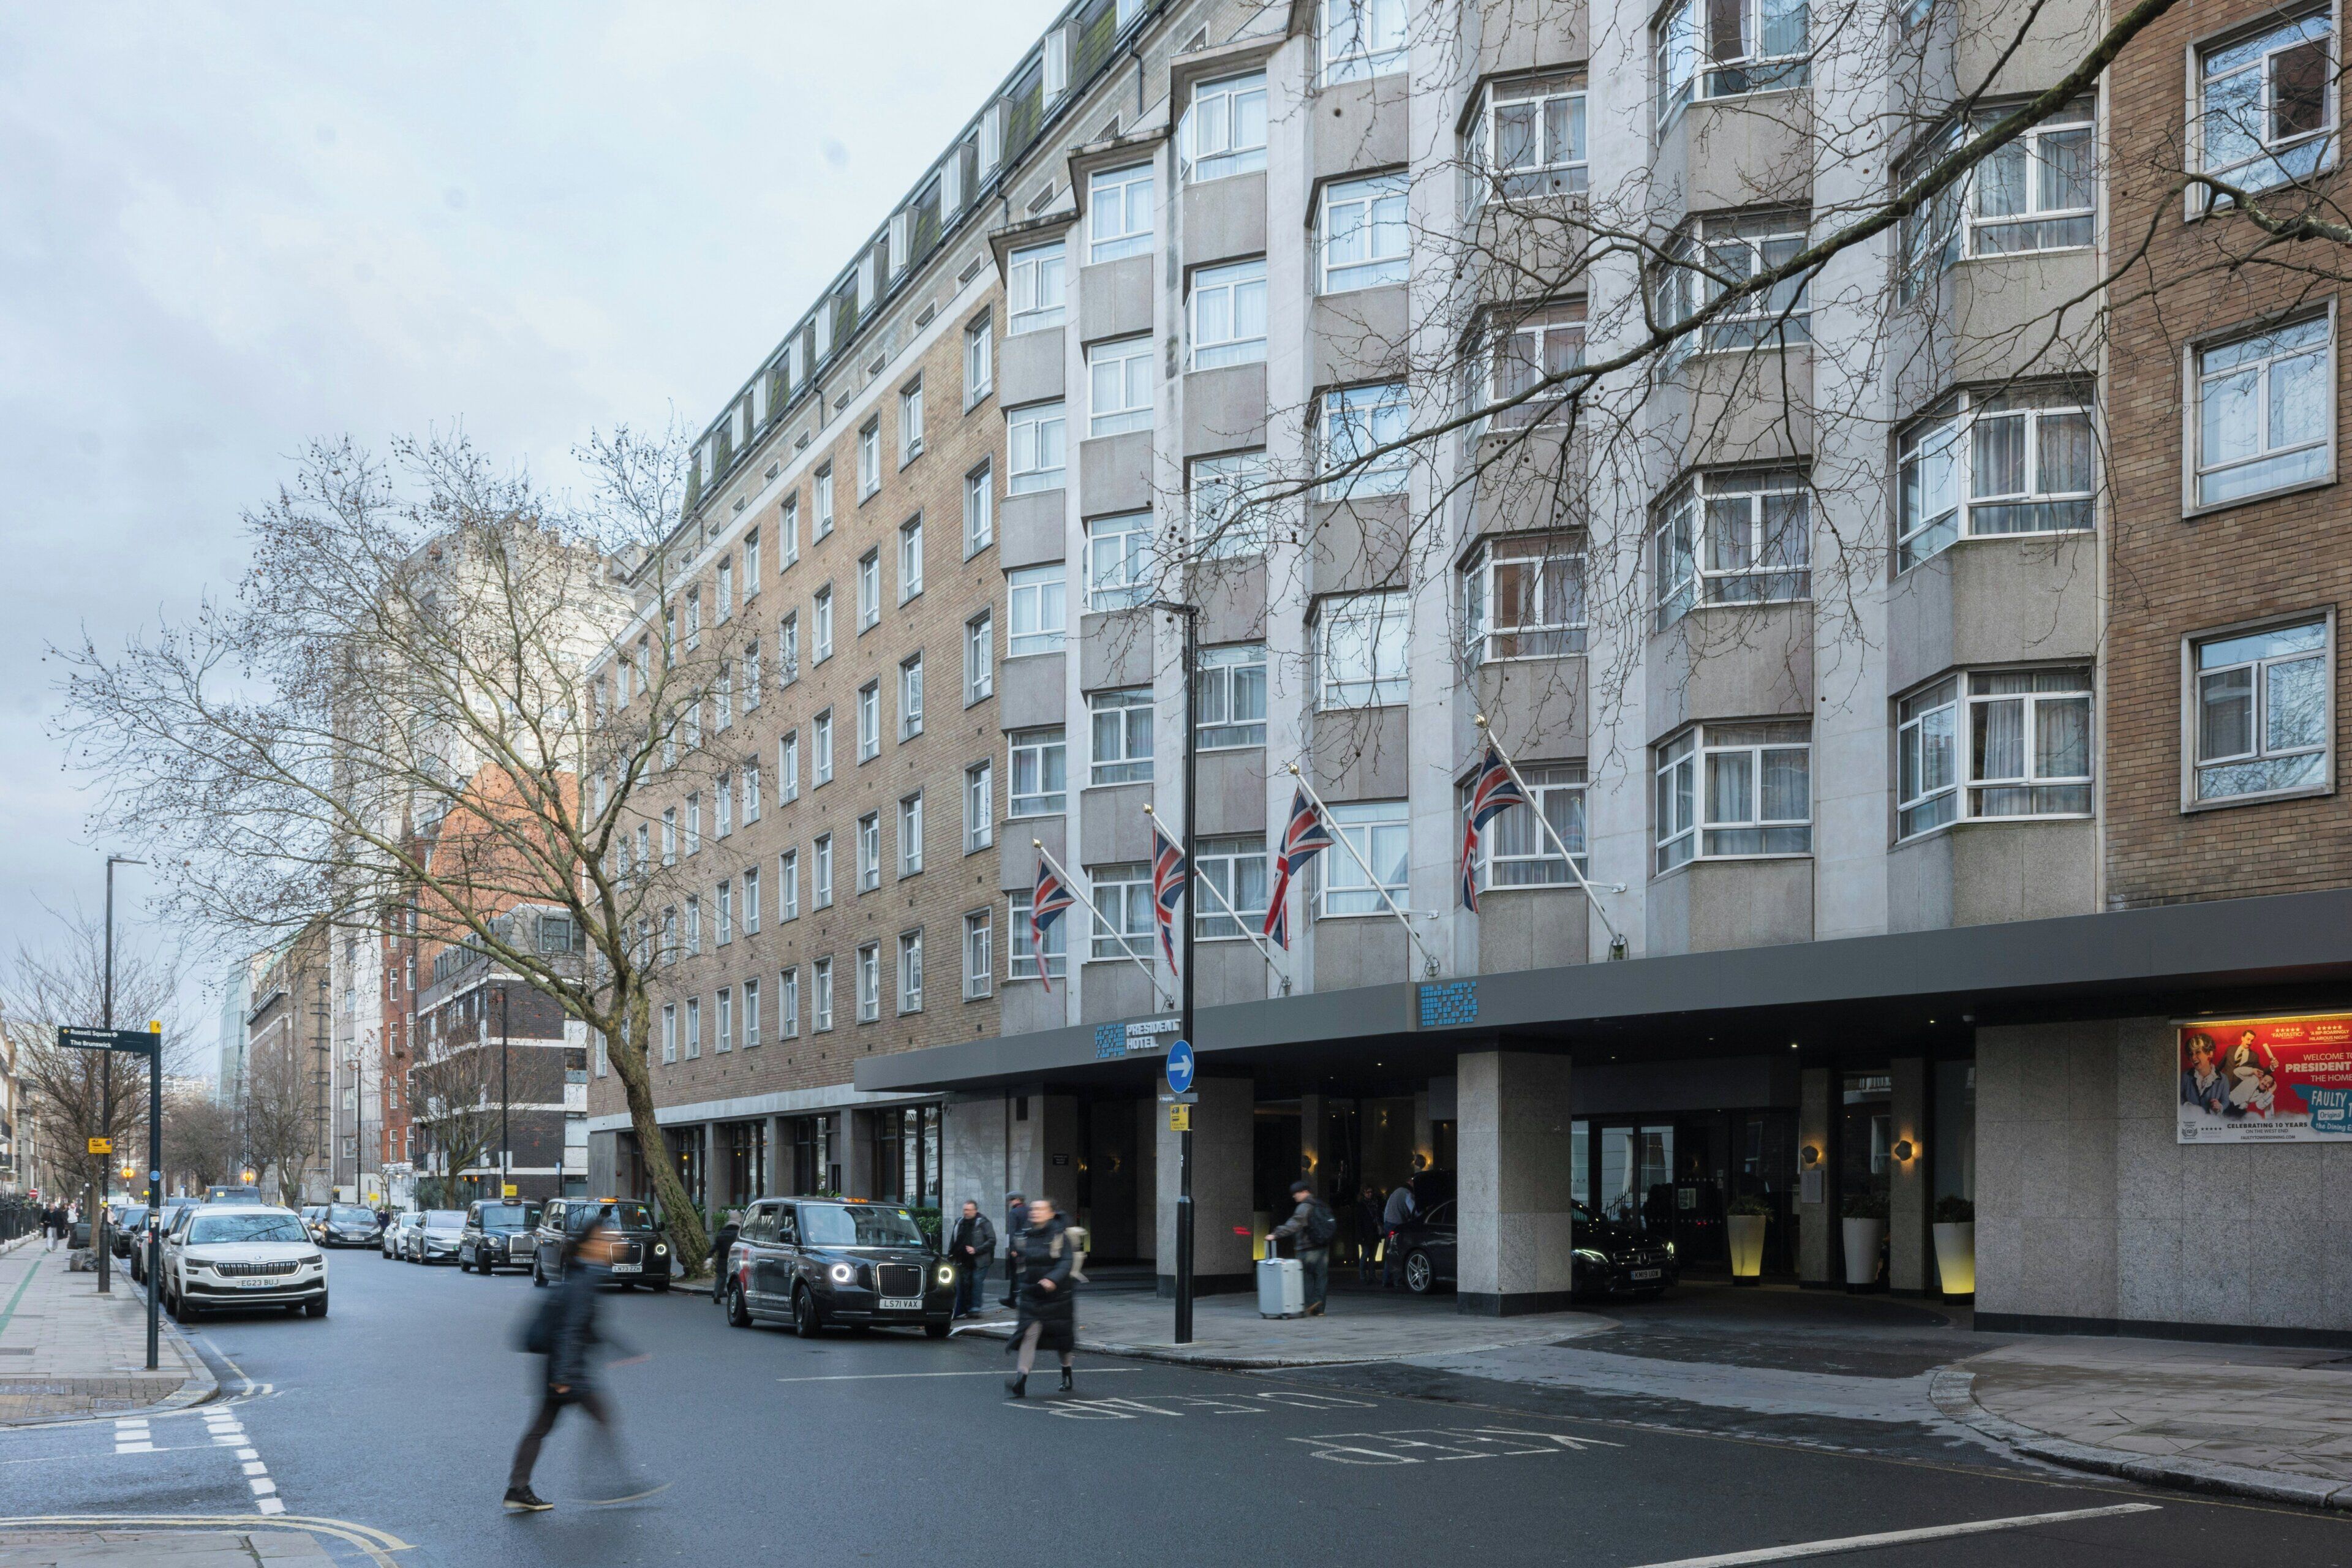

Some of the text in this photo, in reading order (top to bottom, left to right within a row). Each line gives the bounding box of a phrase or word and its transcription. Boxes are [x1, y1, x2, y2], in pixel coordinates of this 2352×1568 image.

[1126, 1019, 1181, 1036] PRESIDENT
[1126, 1036, 1159, 1049] HOTEL
[2285, 1061, 2351, 1072] PRESIDENT
[2312, 1090, 2347, 1107] FAULTY
[2328, 1123, 2346, 1132] Dining
